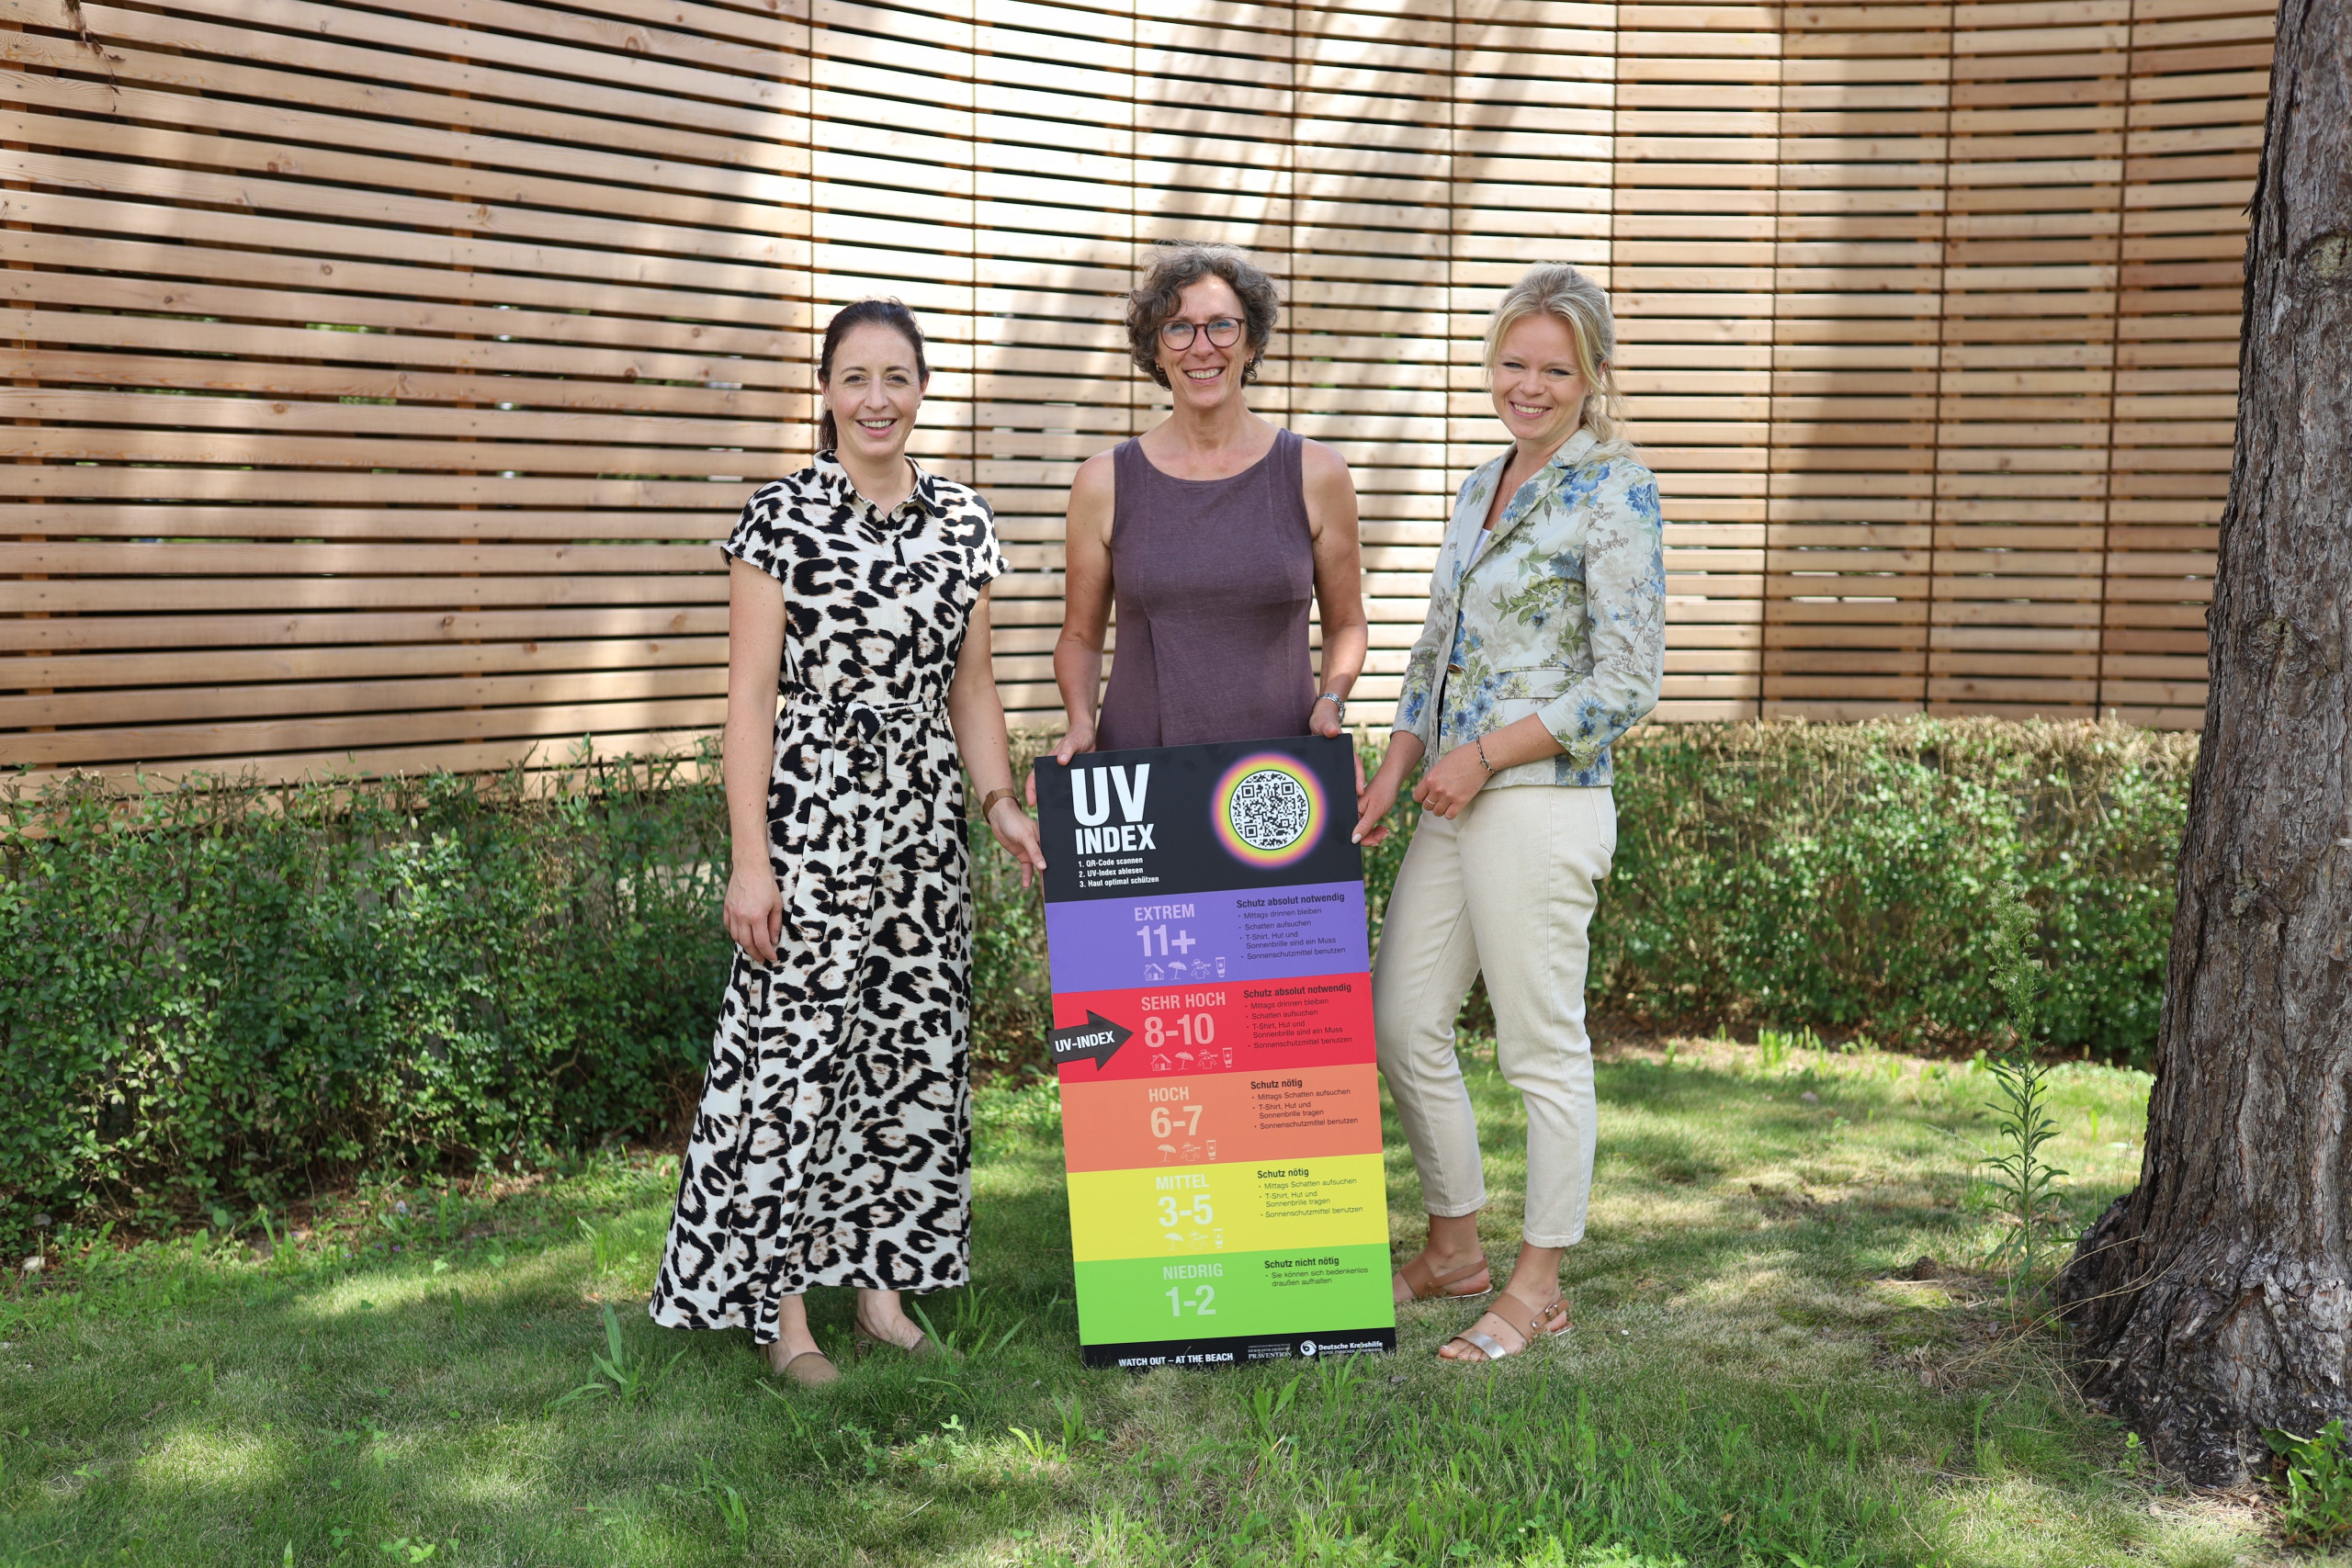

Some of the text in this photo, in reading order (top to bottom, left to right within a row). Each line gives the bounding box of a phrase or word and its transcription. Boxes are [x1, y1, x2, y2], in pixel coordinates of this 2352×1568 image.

[1070, 763, 1150, 827] UV
[1075, 823, 1157, 855] INDEX
[1086, 859, 1114, 867] QR-Code
[1116, 857, 1143, 865] scannen
[1087, 869, 1116, 877] UV-Index
[1118, 867, 1143, 875] ablesen
[1088, 879, 1102, 887] Haut
[1104, 878, 1129, 887] optimal
[1131, 876, 1159, 885] schützen
[1237, 893, 1345, 908] Schutz absolut notwendig
[1134, 903, 1194, 921] EXTREM
[1244, 911, 1268, 919] Mittags
[1270, 909, 1295, 918] drinnen
[1276, 919, 1311, 928] aufsuchen
[1136, 924, 1195, 957] 11+
[1246, 941, 1288, 950] Sonnenbrille
[1247, 949, 1312, 960] Sonnenschutzmittel
[1244, 983, 1351, 998] Schutz absolut notwendig
[1141, 992, 1227, 1010] SEHR HOCH
[1251, 1001, 1275, 1010] Mittags
[1277, 999, 1302, 1008] drinnen
[1283, 1009, 1317, 1017] aufsuchen
[1144, 1013, 1215, 1048] 8-10
[1253, 1030, 1295, 1039] Sonnenbrille
[1055, 1031, 1115, 1053] UV-INDEX
[1253, 1039, 1319, 1049] Sonnenschutzmittel
[1250, 1078, 1303, 1089] Schutz nötig
[1148, 1086, 1190, 1102] HOCH
[1316, 1088, 1351, 1097] aufsuchen
[1149, 1104, 1204, 1138] 6-7
[1259, 1111, 1301, 1119] Sonnenbrille
[1260, 1119, 1325, 1130] Sonnenschutzmittel
[1257, 1168, 1309, 1179] Schutz nötig
[1156, 1174, 1210, 1190] MITTEL
[1264, 1178, 1357, 1190] Mittags Schatten aufsuchen
[1266, 1198, 1330, 1208] Sonnenbrille tragen
[1158, 1194, 1214, 1227] 3-5
[1265, 1206, 1363, 1218] Sonnenschutzmittel benutzen
[1264, 1257, 1340, 1269] Schutz nicht nötig
[1162, 1263, 1224, 1280] NIEDRIG
[1302, 1278, 1332, 1286] aufhalten
[1165, 1284, 1216, 1317] 1-2
[1118, 1358, 1148, 1367] WATCH
[1149, 1357, 1166, 1365] OUT
[1175, 1355, 1185, 1364] AT
[1187, 1354, 1204, 1363] THE
[1205, 1352, 1233, 1362] BEACH
